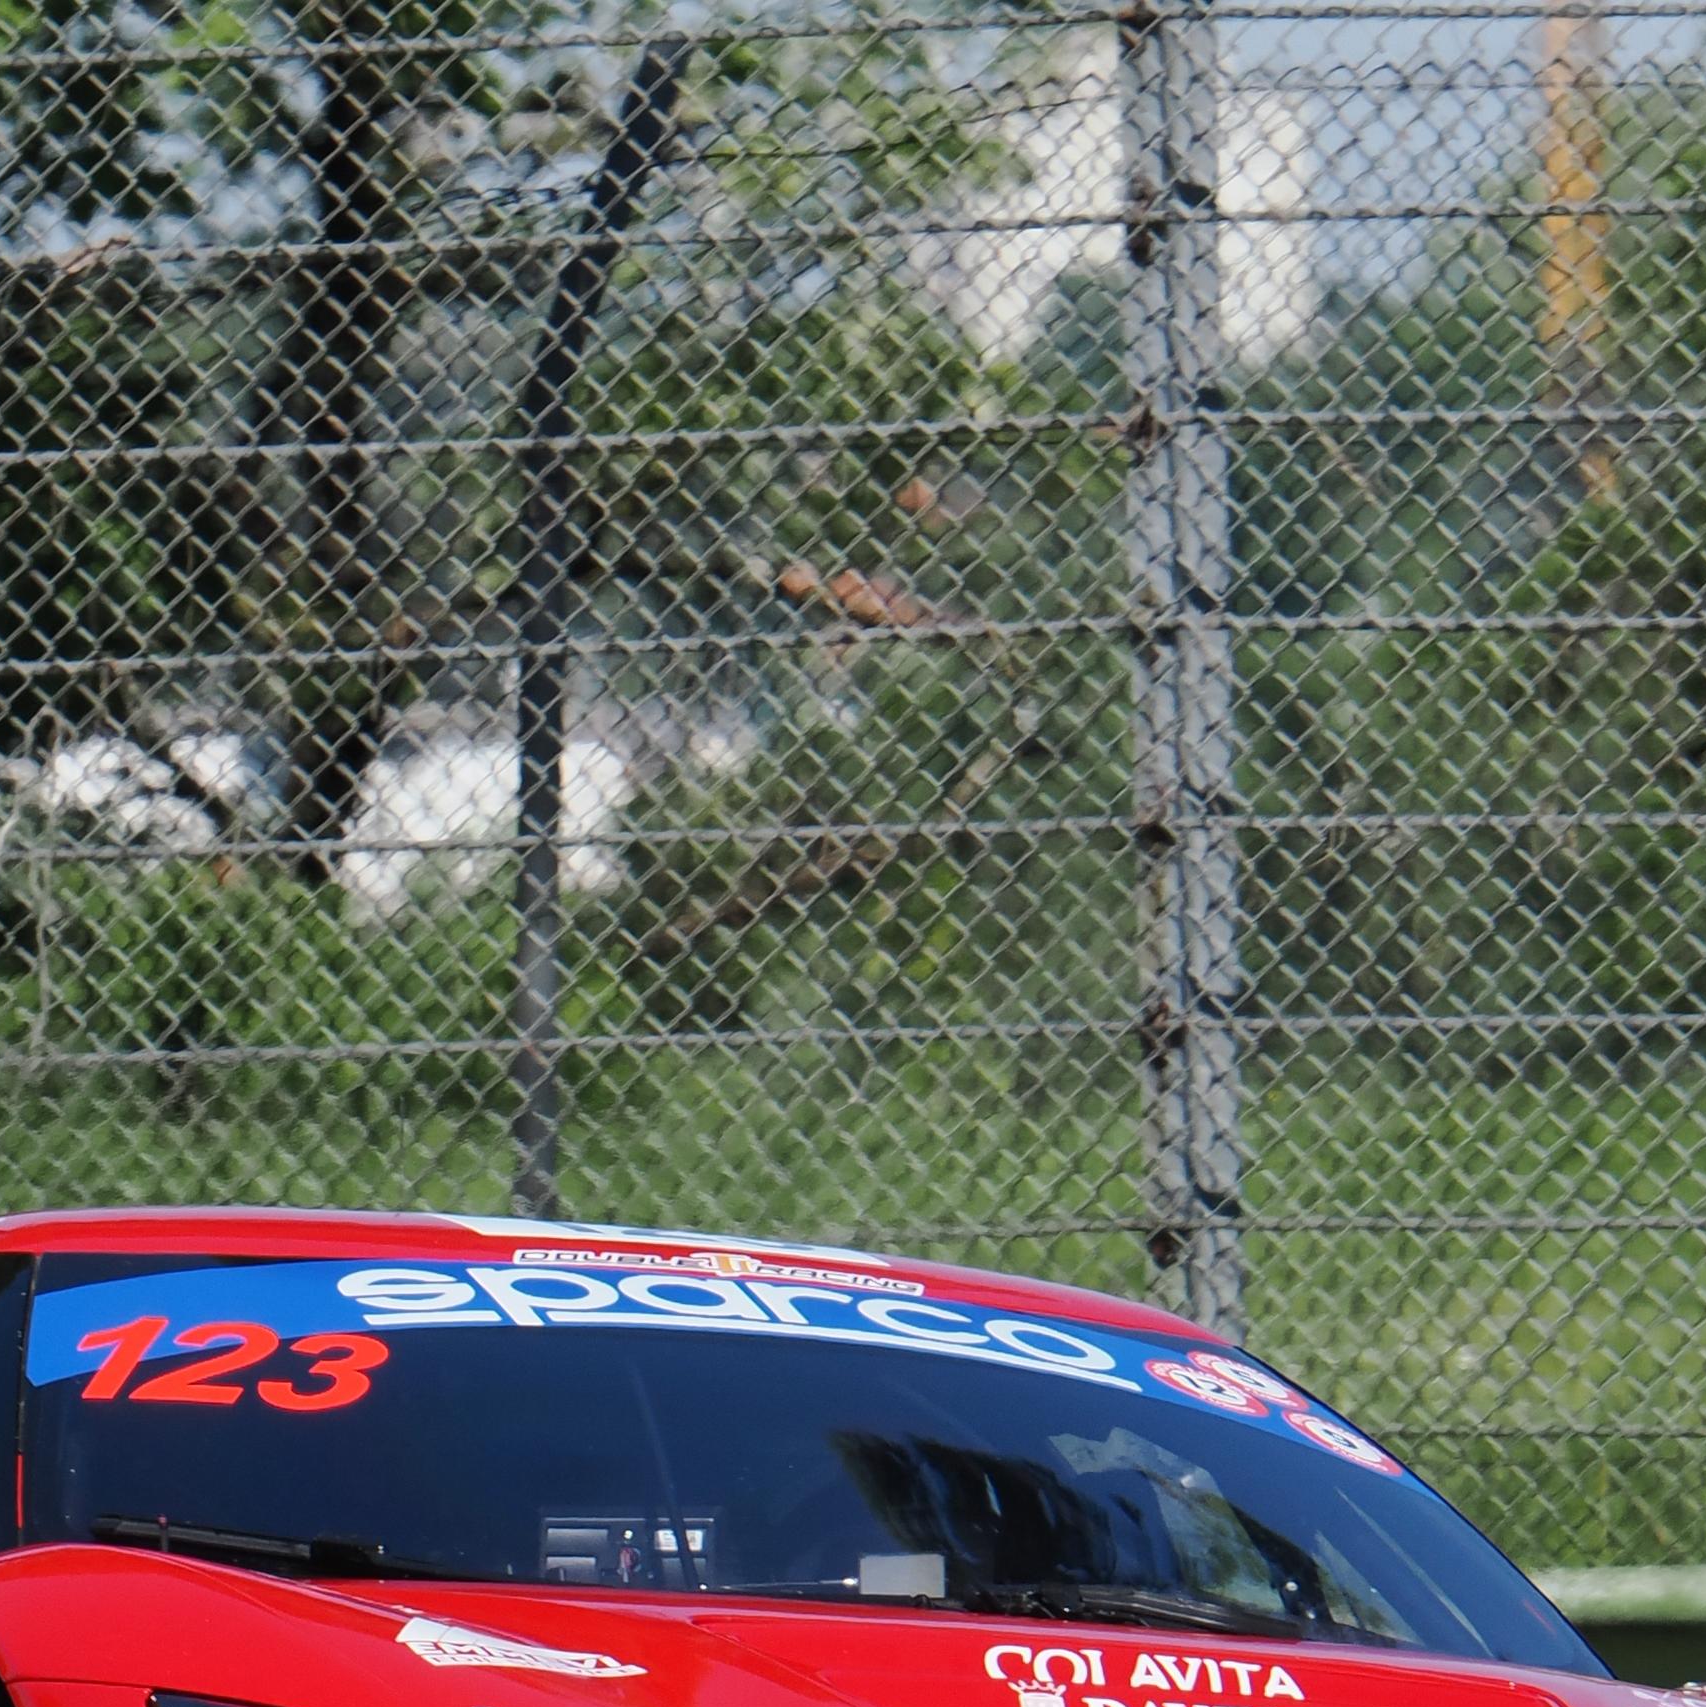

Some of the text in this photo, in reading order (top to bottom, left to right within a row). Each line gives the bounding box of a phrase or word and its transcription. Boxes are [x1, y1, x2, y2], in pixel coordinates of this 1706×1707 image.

[336, 1266, 1118, 1372] sparco
[519, 1250, 713, 1272] DOUBLE
[756, 1264, 919, 1292] RACING
[76, 1315, 390, 1412] 123
